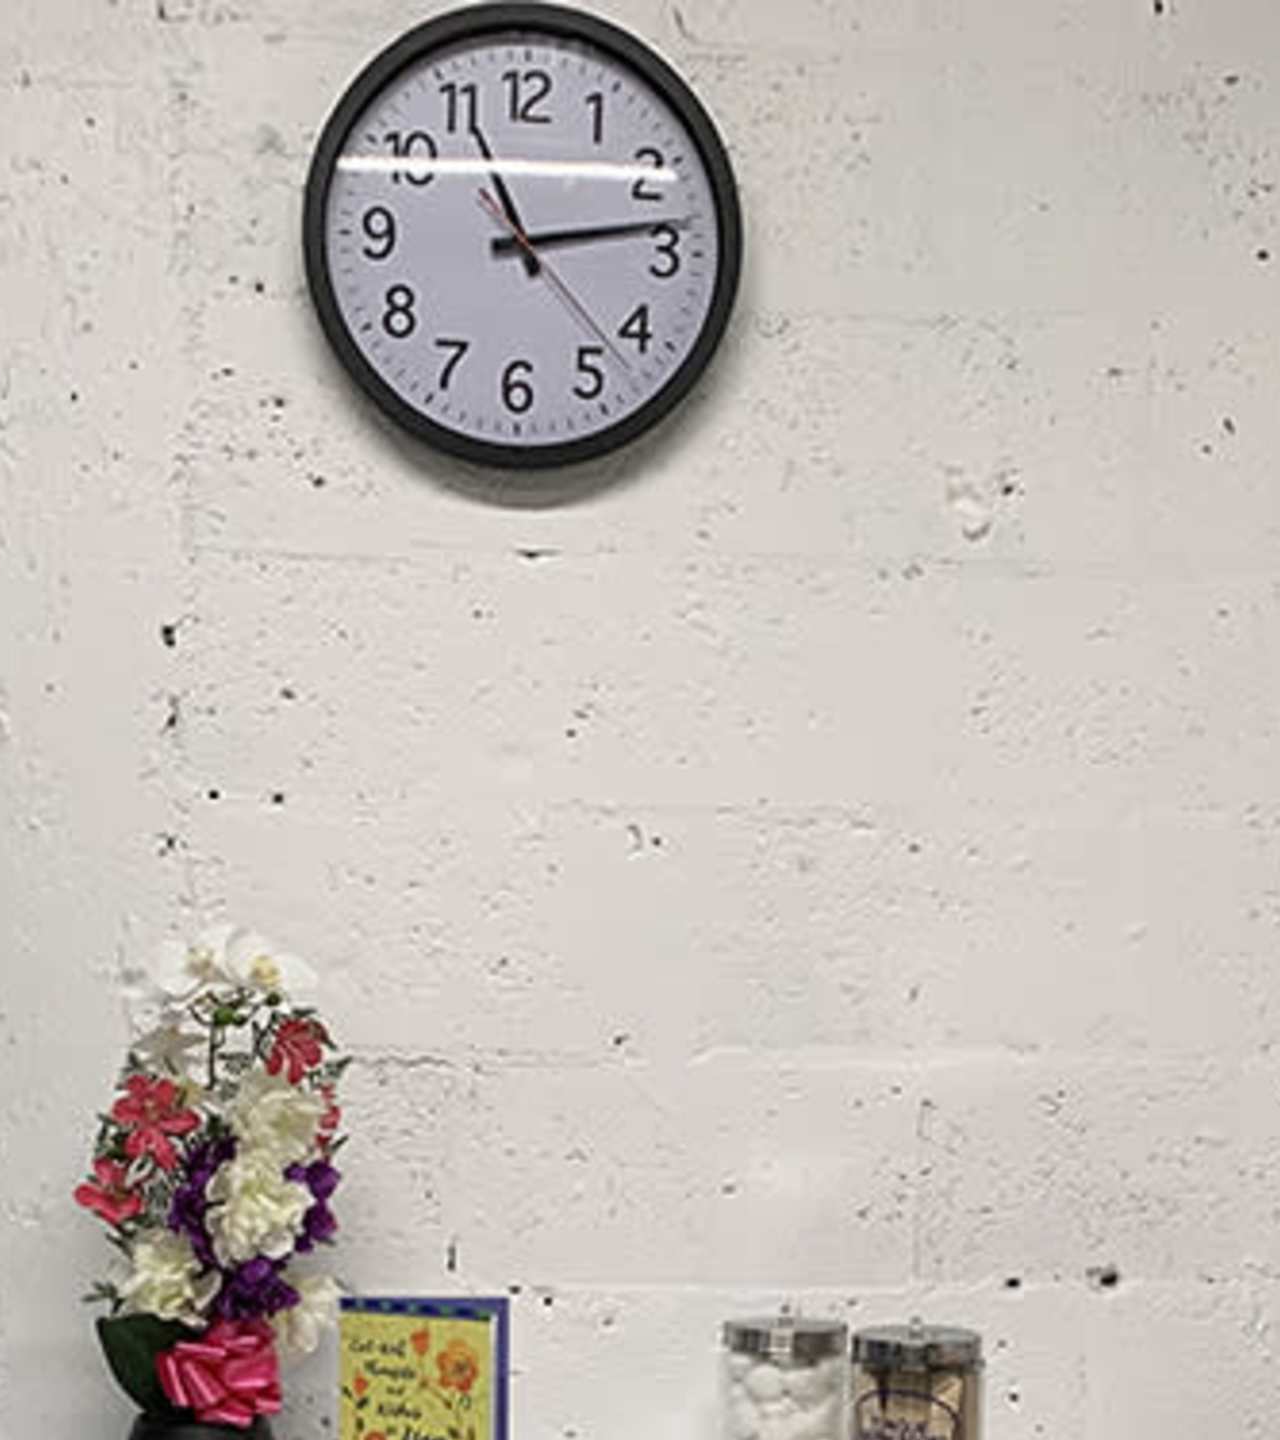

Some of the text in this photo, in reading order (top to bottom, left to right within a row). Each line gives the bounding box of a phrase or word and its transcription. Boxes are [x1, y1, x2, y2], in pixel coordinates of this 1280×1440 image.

[439, 84, 478, 134] 11
[501, 70, 552, 123] 12
[584, 93, 602, 144] 1
[385, 132, 437, 186] 10
[632, 147, 663, 200] 2
[362, 206, 395, 260] 9
[649, 223, 680, 278] 3
[383, 285, 416, 338] 8
[618, 305, 652, 353] 4
[435, 339, 469, 390] 7
[501, 361, 534, 413] 6
[573, 347, 603, 399] 5
